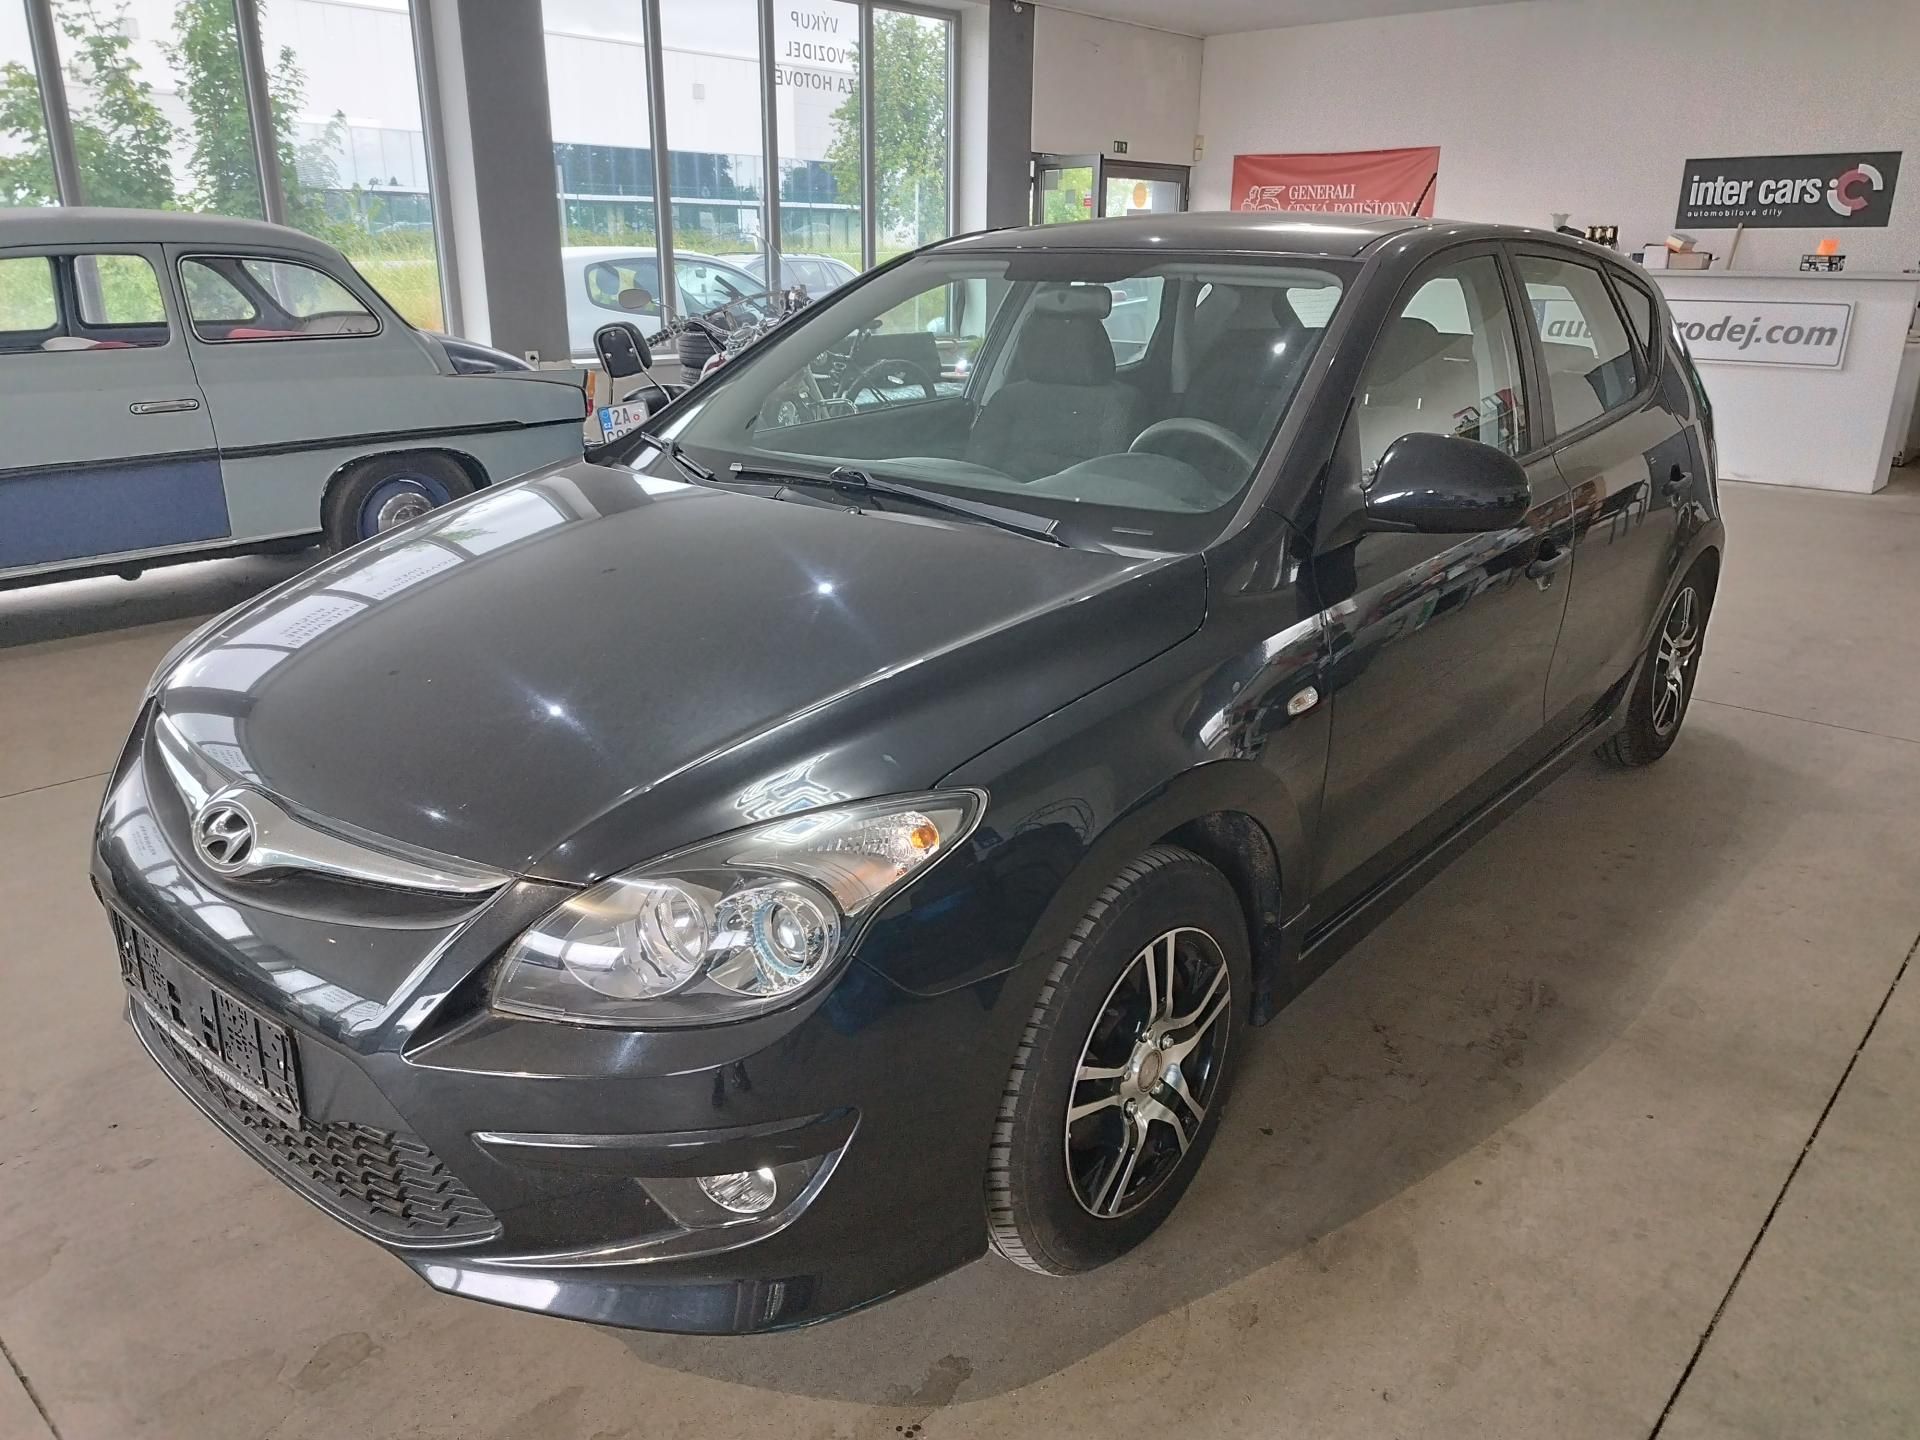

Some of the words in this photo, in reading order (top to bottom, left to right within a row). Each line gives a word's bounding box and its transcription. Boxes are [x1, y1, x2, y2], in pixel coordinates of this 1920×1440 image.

[1288, 183, 1357, 200] GENERALI
[1688, 175, 1753, 206] inter
[1758, 178, 1823, 205] cars
[612, 407, 632, 425] 2A
